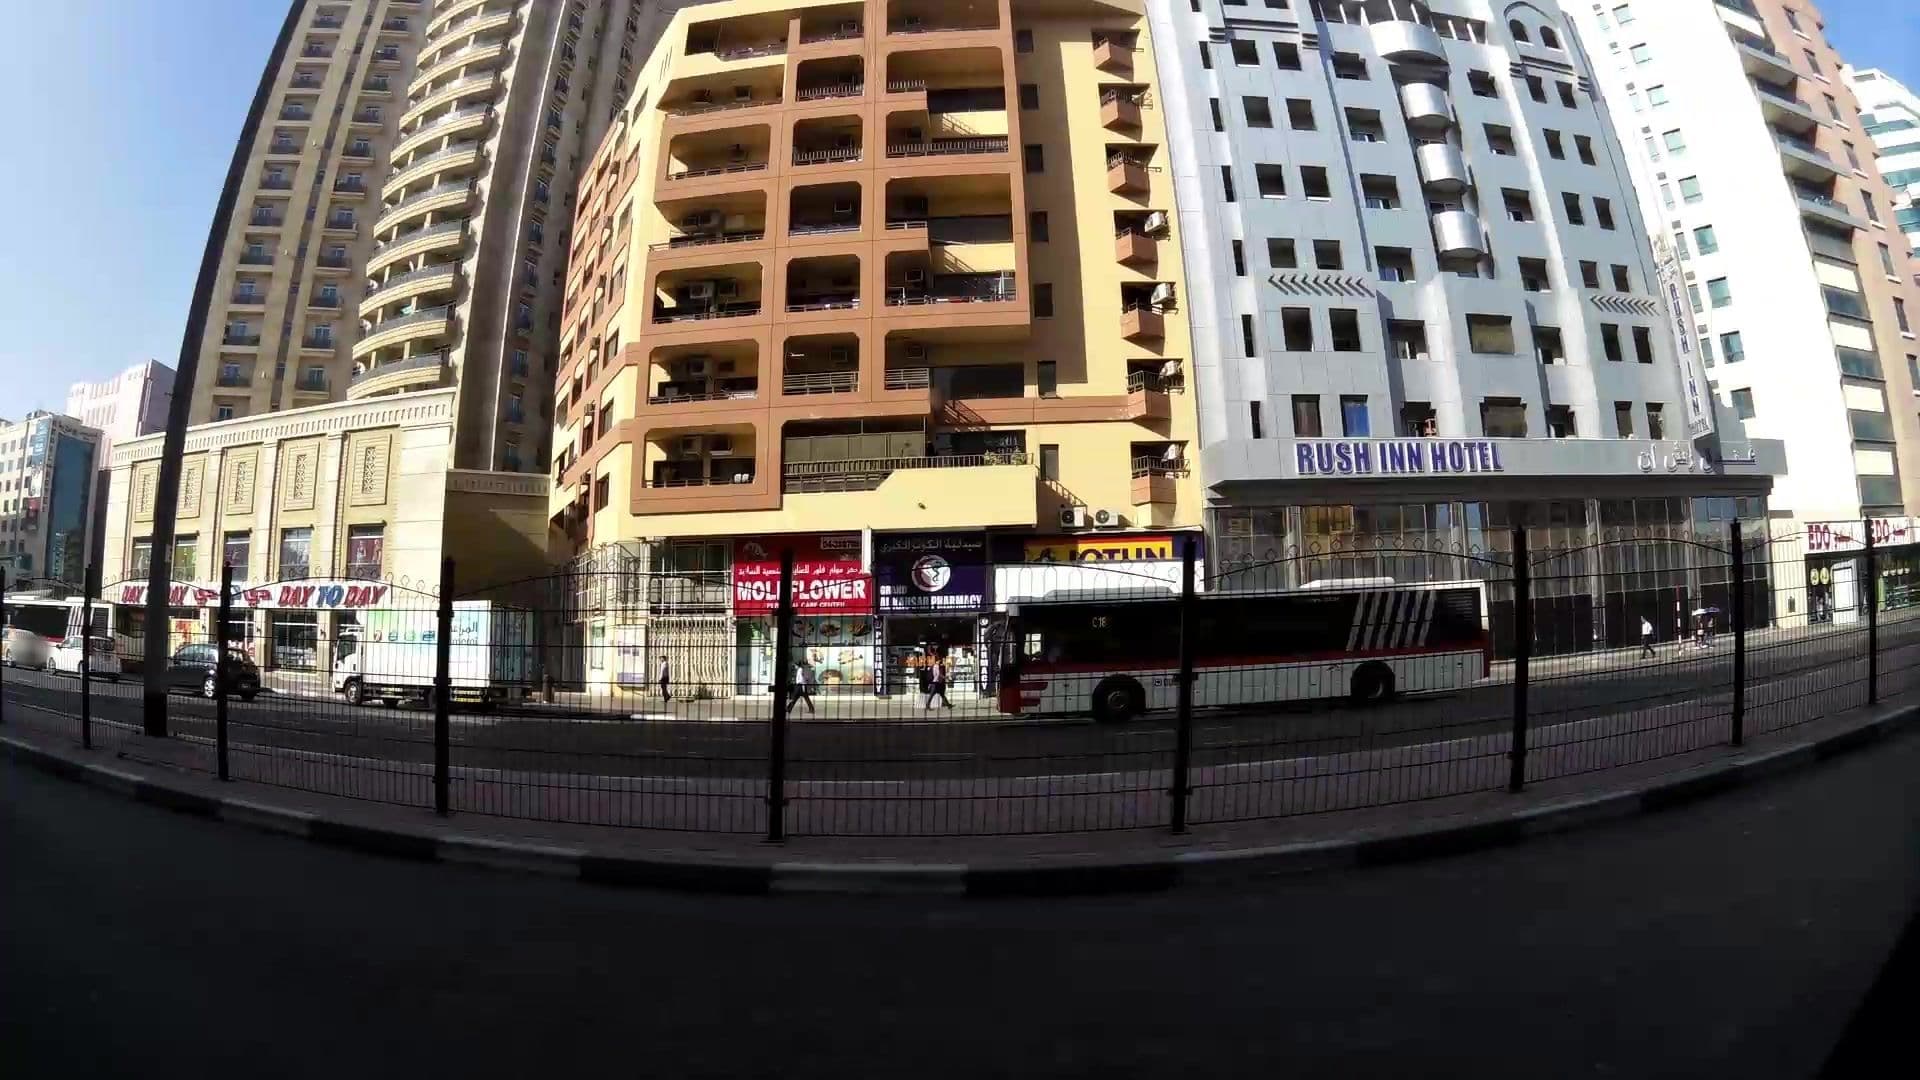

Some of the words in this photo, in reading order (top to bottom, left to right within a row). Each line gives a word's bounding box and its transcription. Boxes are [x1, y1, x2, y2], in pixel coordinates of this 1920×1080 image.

[1669, 282, 1689, 355] RUSH
[1686, 361, 1701, 417] INN
[1296, 441, 1372, 474] RUSH
[1377, 441, 1424, 473] INN
[1429, 441, 1504, 473] HOTEL
[1807, 523, 1831, 550] EDO
[121, 586, 146, 604] DAY
[277, 585, 316, 607] DAY
[316, 585, 345, 606] TO
[343, 585, 388, 607] DAY
[791, 579, 866, 600] FLOWER
[880, 585, 908, 595] GRAND
[930, 595, 982, 609] PHARMACY
[450, 622, 479, 637] المراع
[874, 631, 883, 693] PHARMACY
